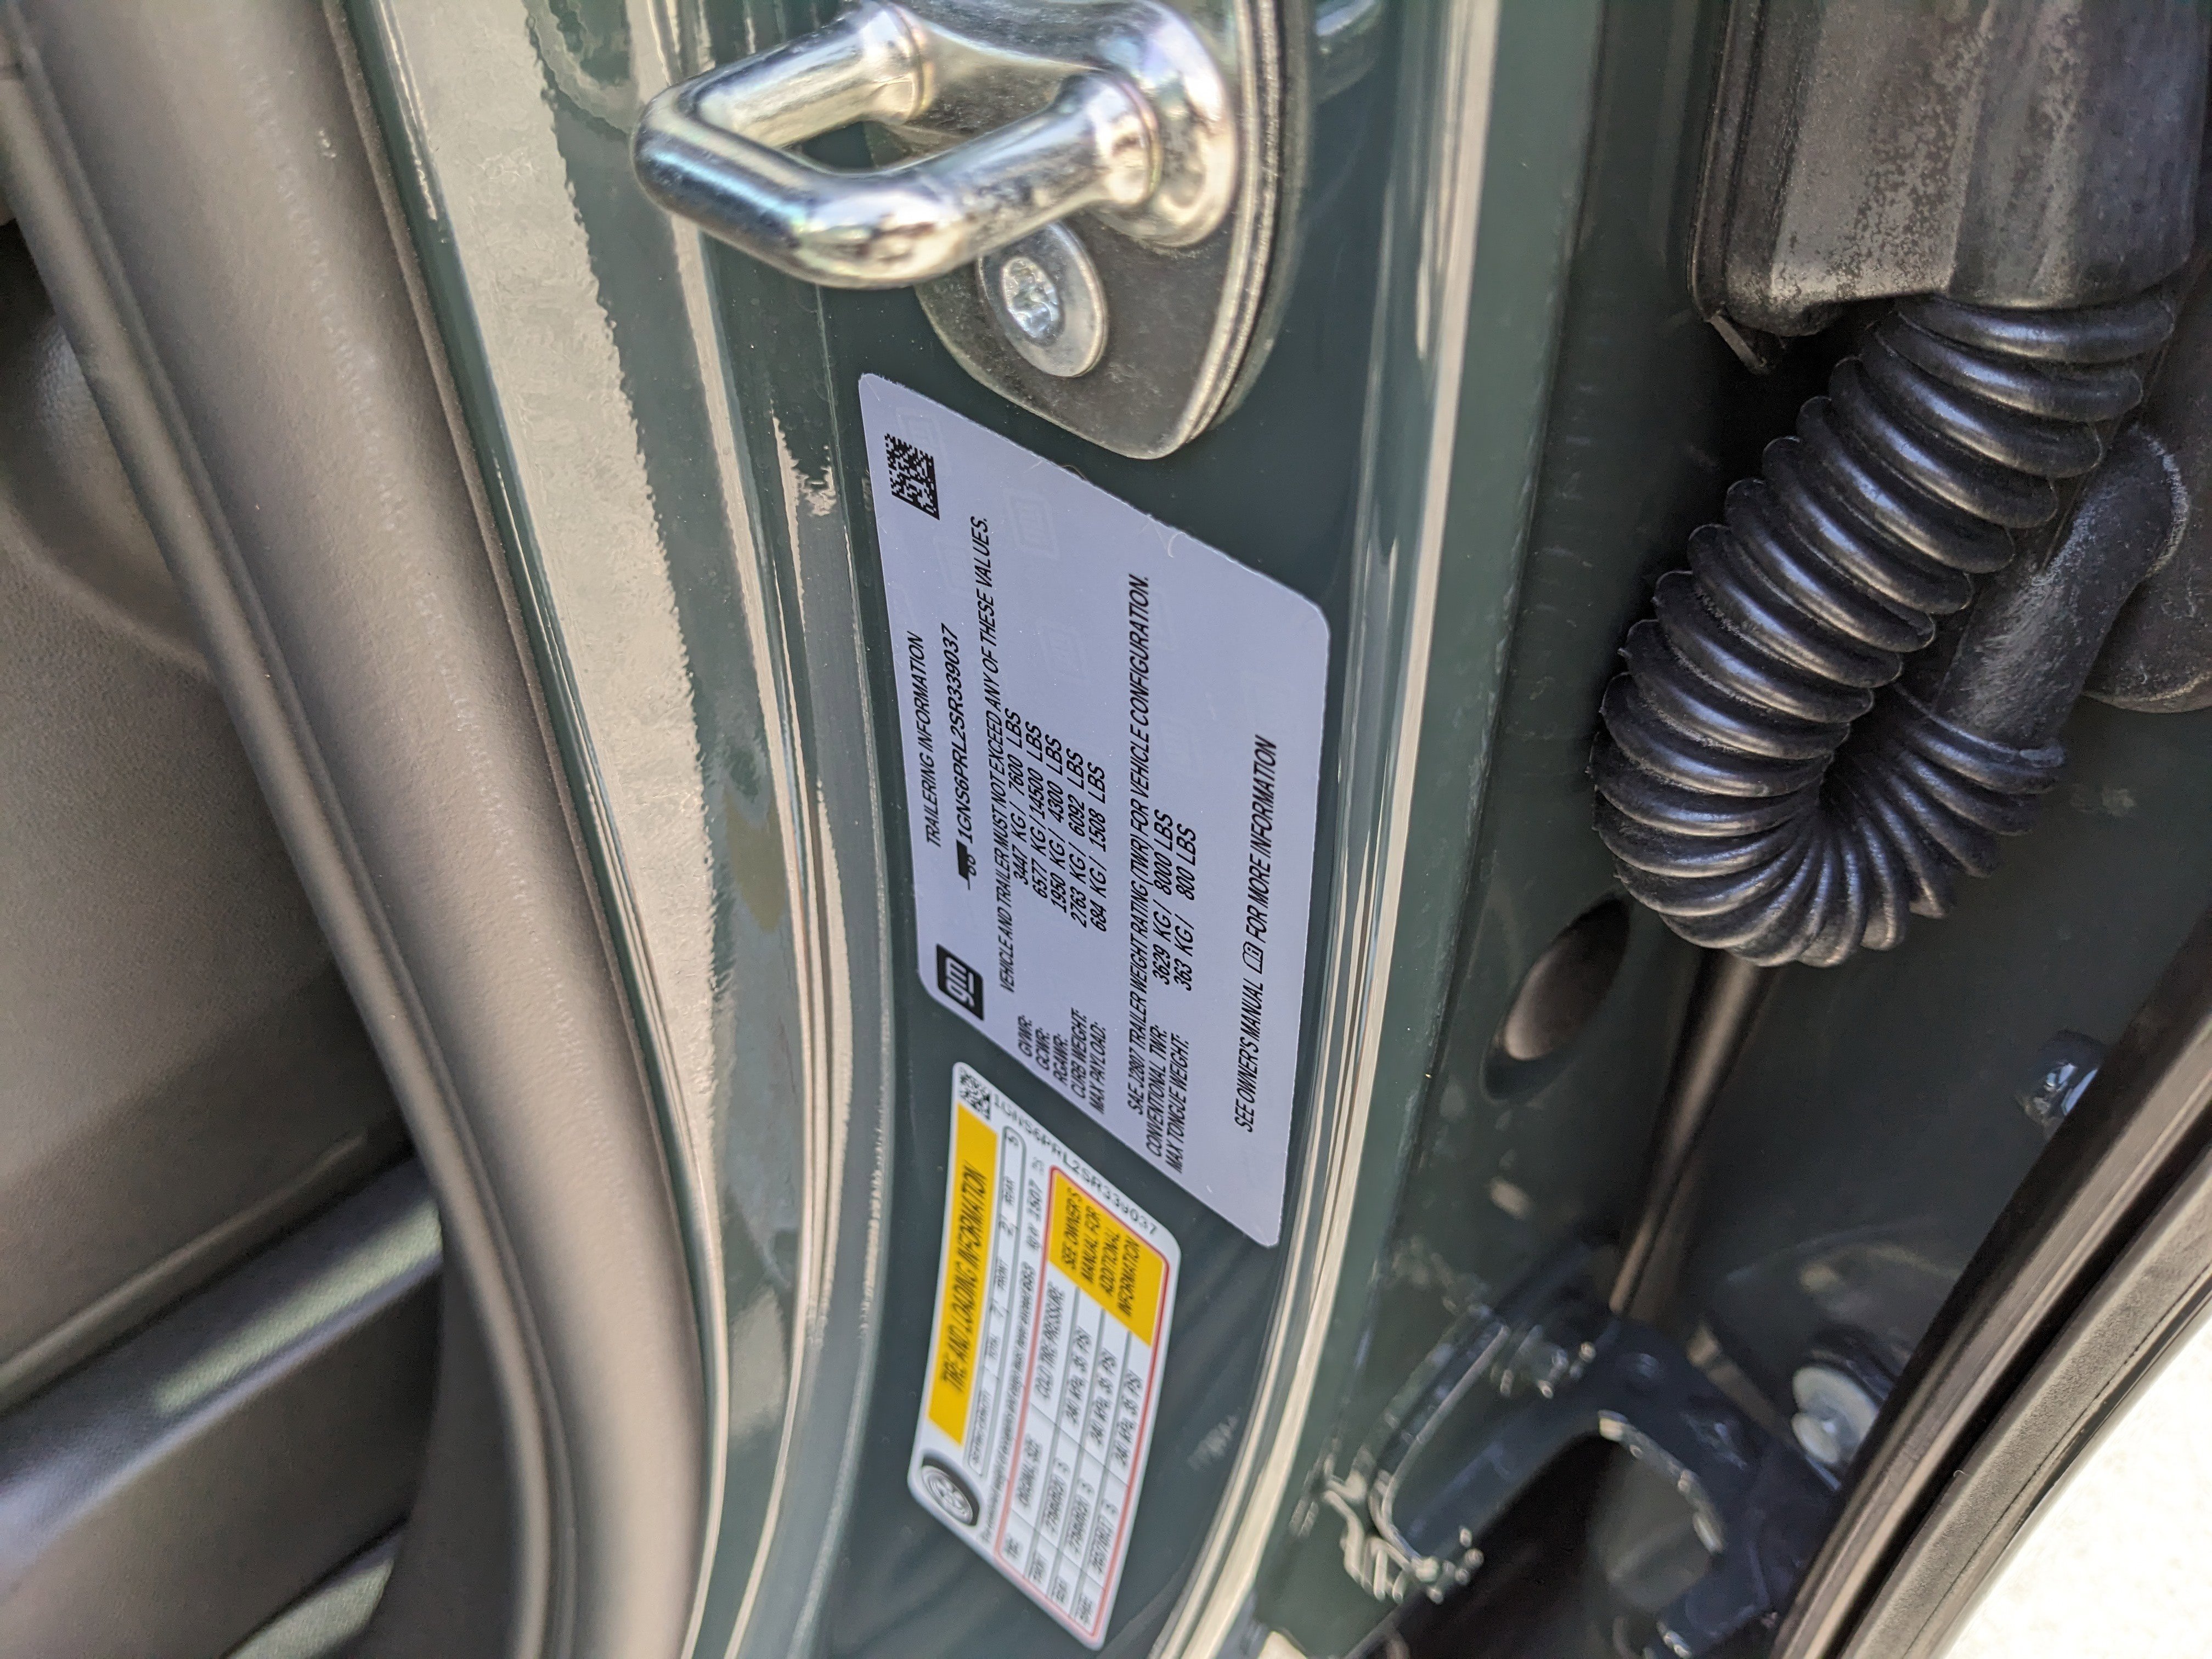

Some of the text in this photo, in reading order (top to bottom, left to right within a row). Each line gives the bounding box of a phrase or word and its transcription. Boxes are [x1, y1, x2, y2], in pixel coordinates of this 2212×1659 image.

[907, 630, 941, 847] TRAILERING INFORMATION
[941, 622, 973, 844] 1GNS6PRL2SR339037
[1004, 708, 1022, 749] LBS
[1025, 721, 1042, 762] LBS
[970, 516, 1014, 992] VEHICLE AND TRAILER MUST NOT EXCEED ANY OF THESE VALUES.
[1007, 753, 1024, 796] 7600
[1045, 734, 1063, 775] LBS
[1065, 748, 1084, 790] LBS
[1046, 780, 1064, 823] 4300
[1087, 761, 1105, 804] LBS
[1067, 793, 1085, 837] 6092
[1088, 808, 1106, 852] 1508
[1154, 809, 1173, 851] LBS
[1012, 843, 1028, 885] 3447
[1127, 573, 1154, 1115] SAE J2807 TRAILER WEIGHT RATING (TWR) FOR VEHICLE CONFIGURATION.
[1176, 823, 1196, 866] LBS
[1031, 857, 1047, 898] 6577
[1049, 872, 1066, 913] 1950
[1153, 851, 1172, 895] 8000
[1175, 865, 1195, 900] 800
[1069, 885, 1086, 928] 2763
[1090, 899, 1106, 932] 684
[1234, 734, 1276, 1132] SEE OWNER'S MANUAL FOR MORE INFORMATION
[943, 952, 975, 1012] gm
[1152, 943, 1170, 985] 3629
[1173, 958, 1192, 991] 363
[1017, 1014, 1032, 1057] GVWR:
[1035, 1027, 1049, 1070] GCWR:
[1071, 1007, 1087, 1063] WEIGHT:
[1089, 1022, 1105, 1085] PAYLOAD:
[1149, 1024, 1166, 1060] TWR:
[1053, 1033, 1068, 1085] RGAWR:
[1070, 1059, 1086, 1099] CURB
[1169, 1032, 1188, 1091] WEIGHT:
[1089, 1081, 1104, 1114] MAX
[1146, 1060, 1166, 1156] CONVENTIONAL
[1166, 1085, 1186, 1143] TONGUE
[1165, 1139, 1183, 1173] MAX
[1060, 1186, 1082, 1270] SEE OWNERS
[1080, 1205, 1101, 1284] MANUAL FOR
[940, 1162, 987, 1393] TIRE AND LOADING INFORMATION
[1098, 1229, 1121, 1297] ADDITIONAL
[1116, 1235, 1141, 1317] INFORMATION
